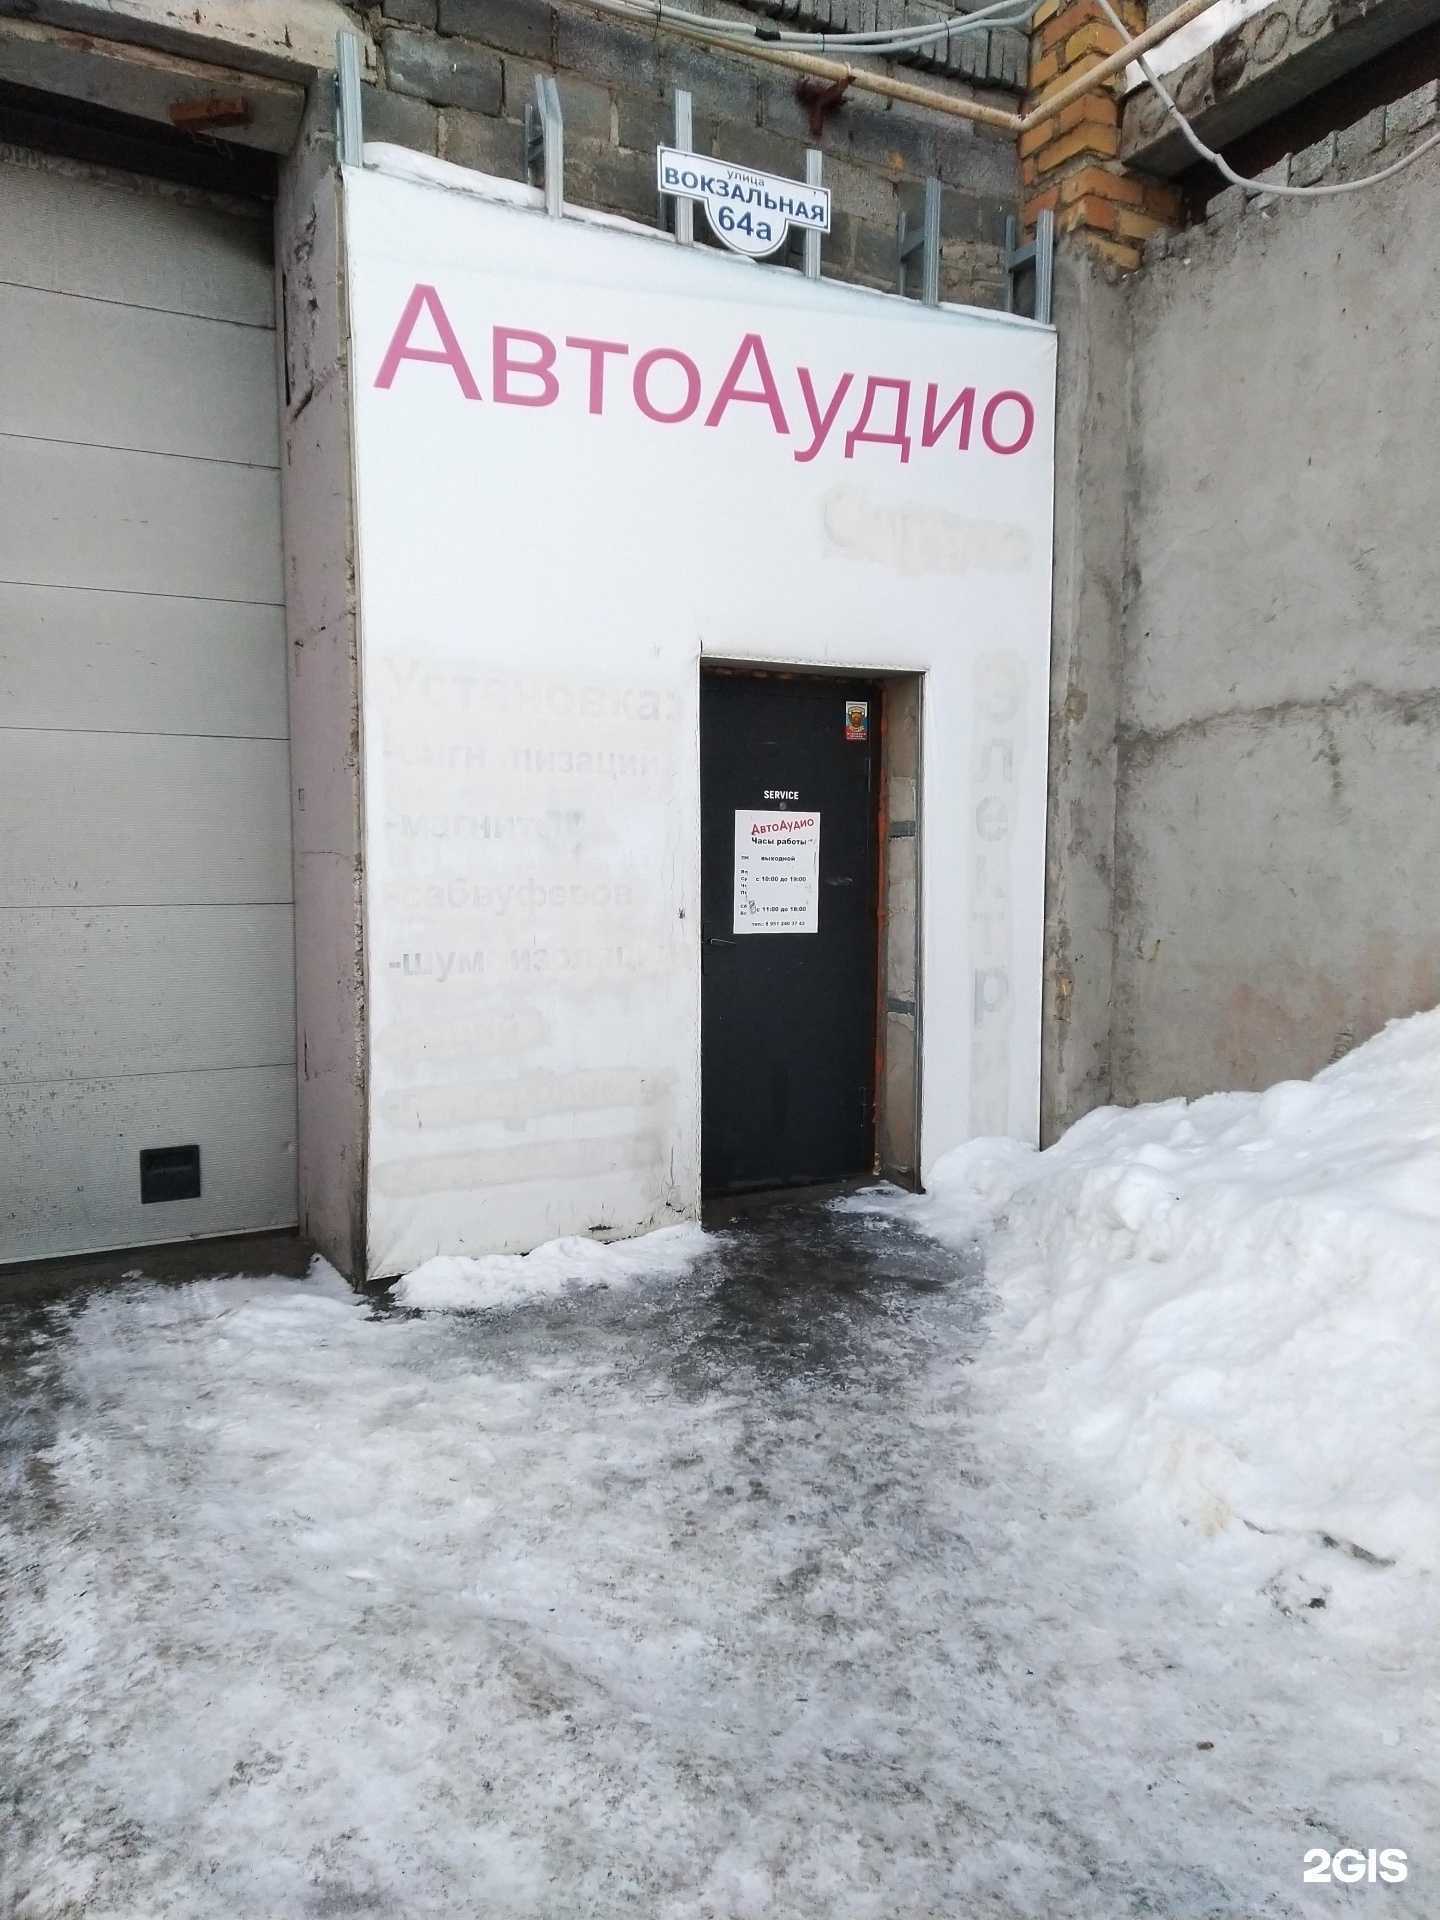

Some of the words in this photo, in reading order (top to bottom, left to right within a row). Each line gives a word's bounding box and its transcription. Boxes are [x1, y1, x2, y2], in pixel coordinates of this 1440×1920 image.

[727, 169, 765, 187] улица
[664, 166, 825, 222] ВОКЗАЛЬНАЯ
[718, 206, 772, 242] 64а
[374, 283, 1036, 463] АвтоАудио
[763, 790, 800, 800] SERVICE
[751, 818, 815, 836] АвтоАудио
[751, 837, 775, 845] Часы
[776, 837, 807, 847] работы
